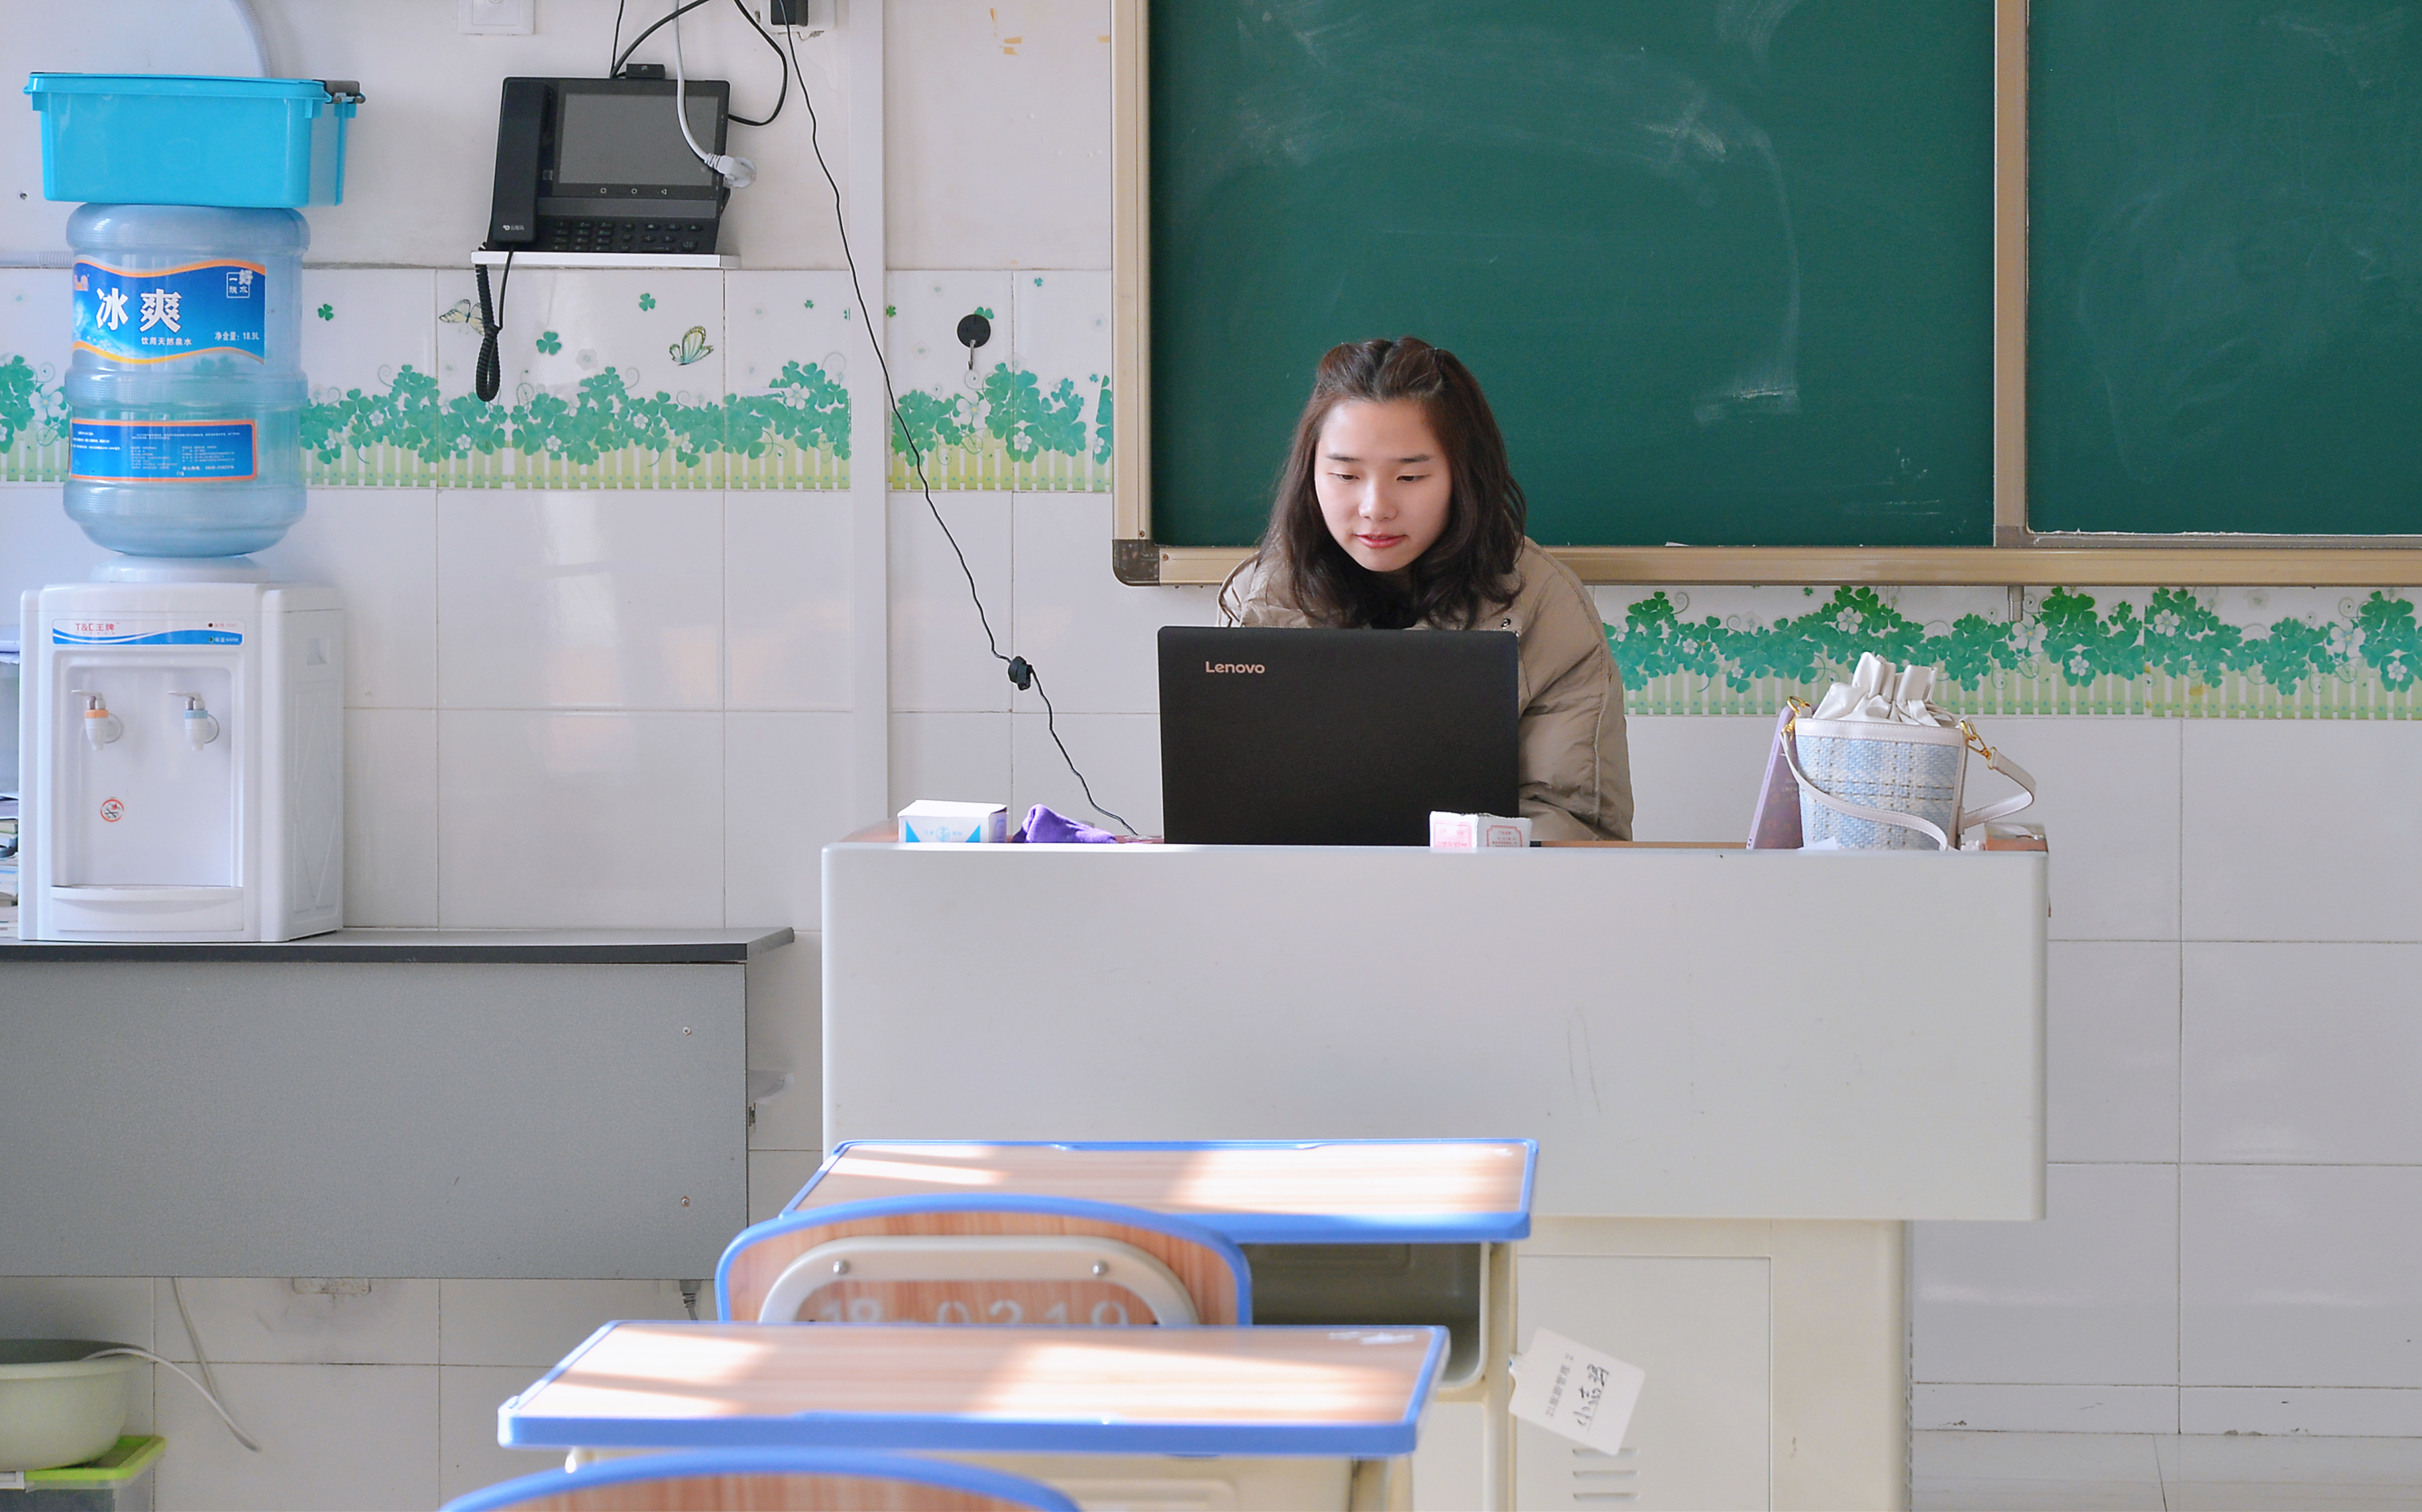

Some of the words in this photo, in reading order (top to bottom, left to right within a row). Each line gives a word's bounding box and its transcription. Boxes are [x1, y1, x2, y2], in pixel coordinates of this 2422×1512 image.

[95, 287, 182, 333] 冰爽
[141, 337, 192, 346] 饮用天然泉水
[1205, 661, 1266, 674] Lenovo
